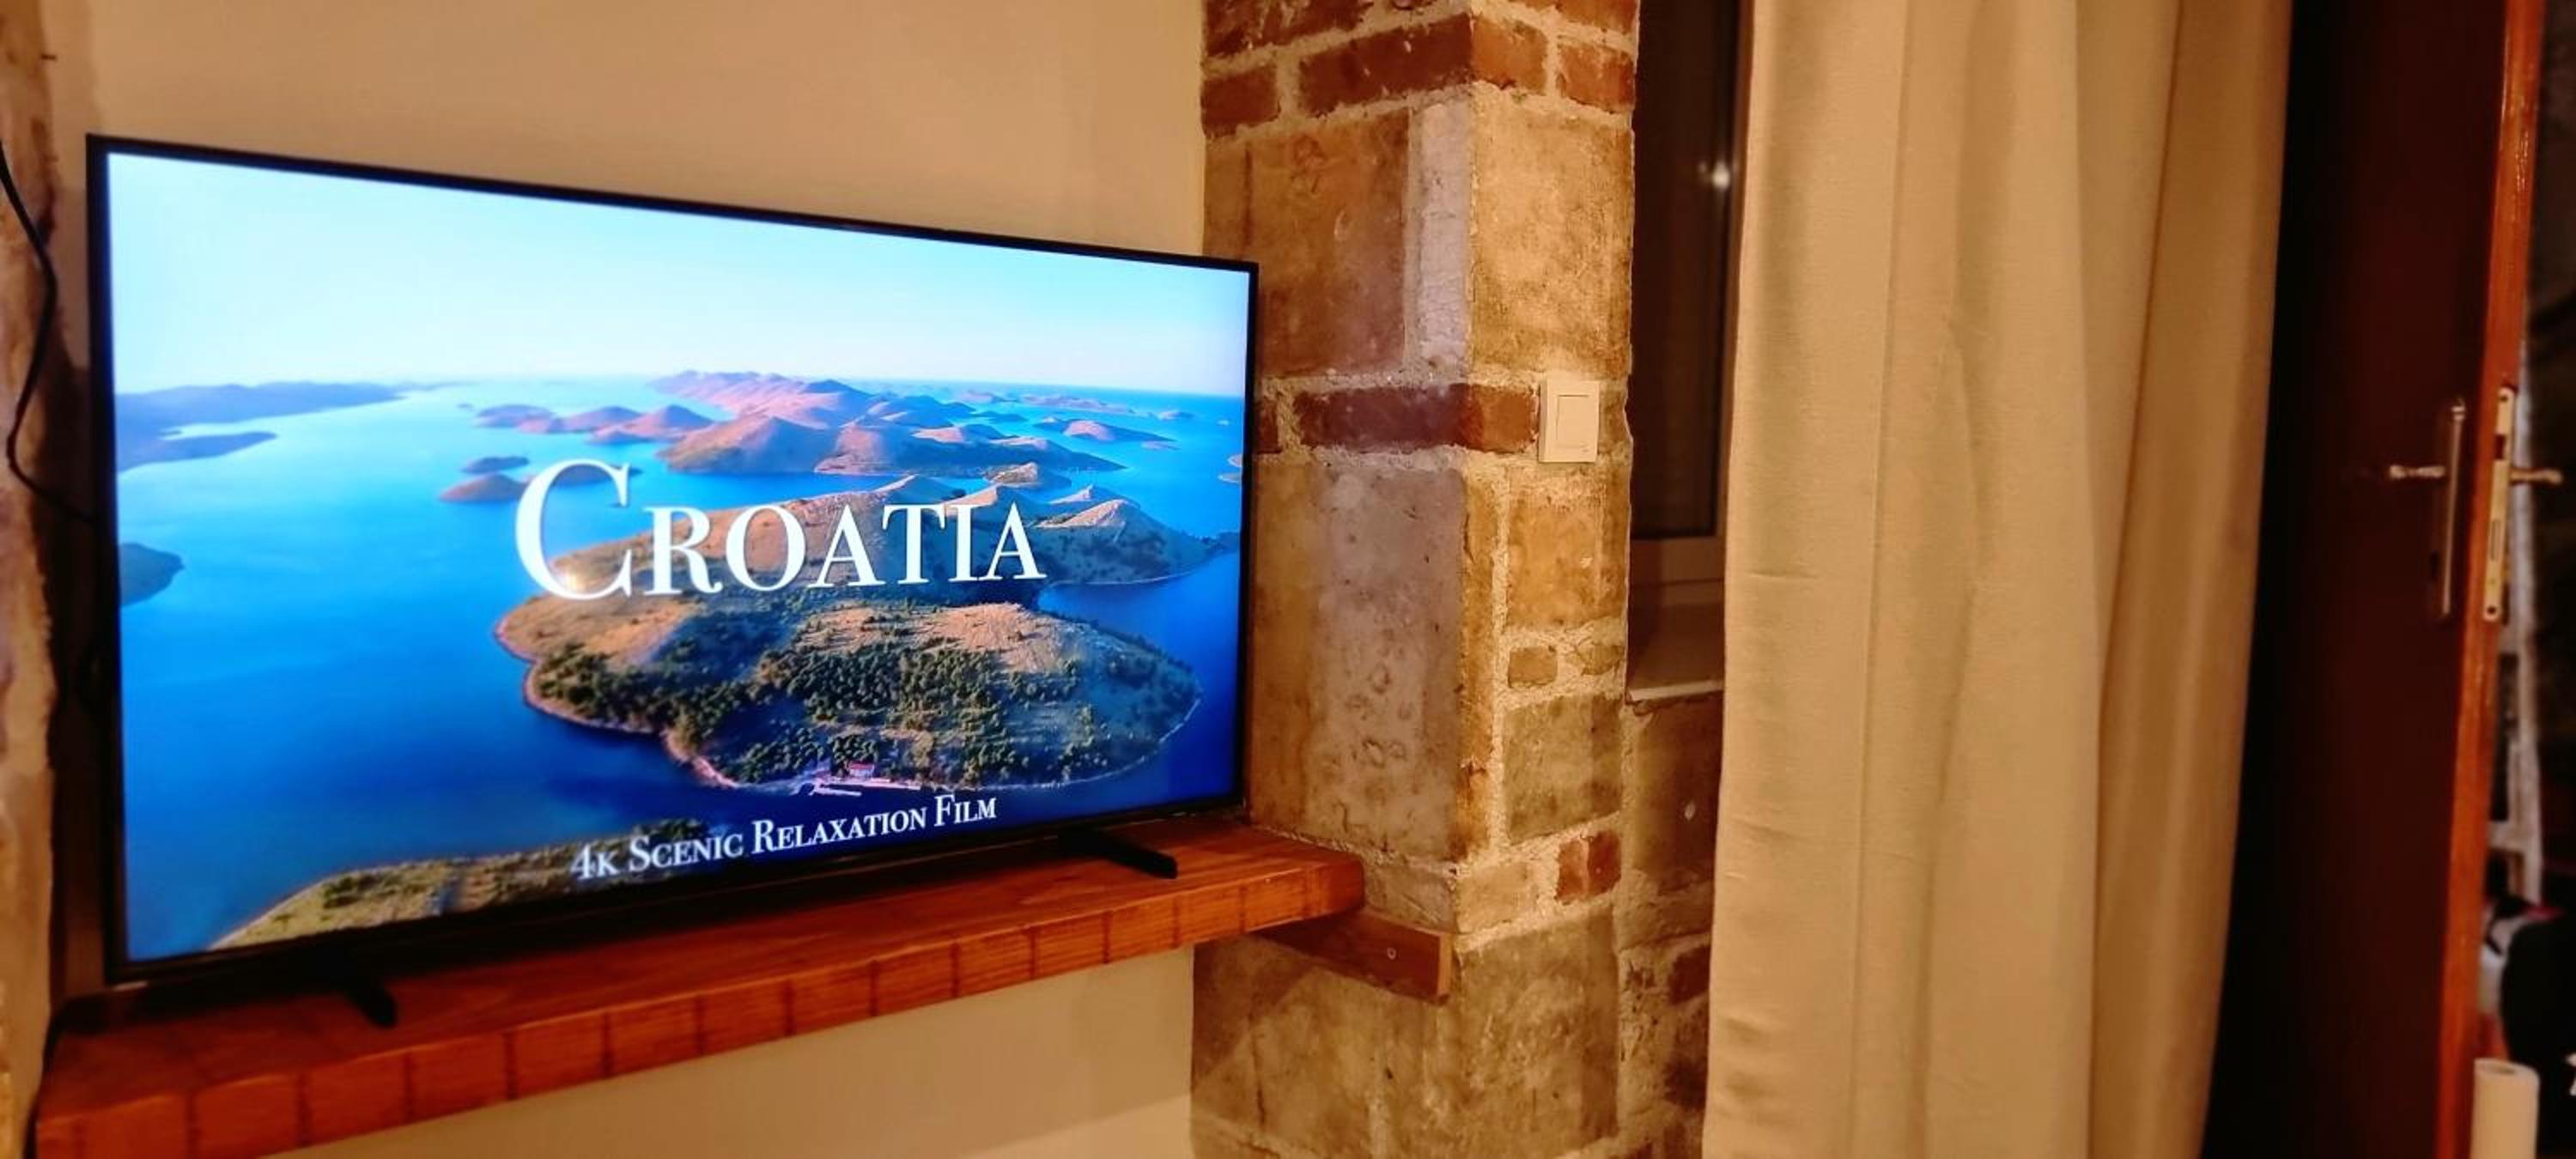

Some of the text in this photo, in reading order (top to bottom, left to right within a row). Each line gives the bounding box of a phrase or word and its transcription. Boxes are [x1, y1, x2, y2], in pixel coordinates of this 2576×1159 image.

[515, 458, 1047, 599] CROATIA
[570, 793, 997, 880] 4K SCENIC RELAXATION FILM
